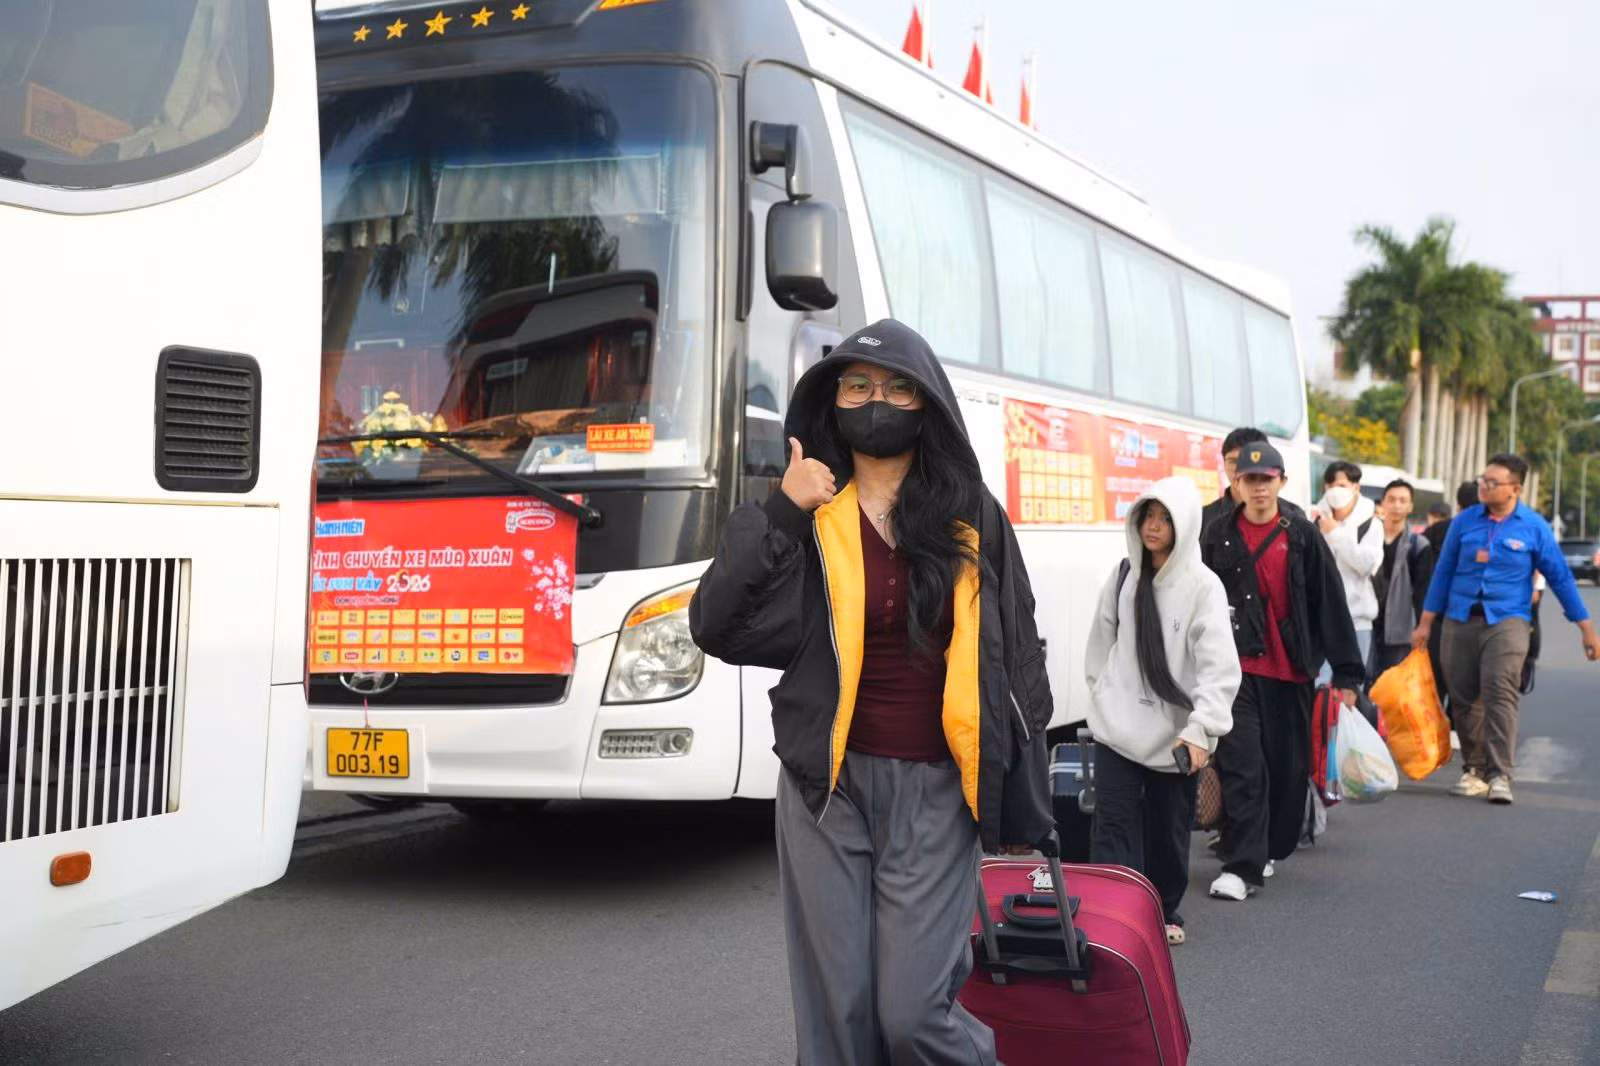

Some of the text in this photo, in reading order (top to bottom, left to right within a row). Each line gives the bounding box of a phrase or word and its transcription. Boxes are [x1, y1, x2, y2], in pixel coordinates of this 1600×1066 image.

[314, 546, 513, 569] ÌNH CHUYẾN XE MÙA XUÂN
[387, 570, 431, 592] 2026
[350, 731, 384, 751] 77F
[336, 753, 399, 774] 003.19
